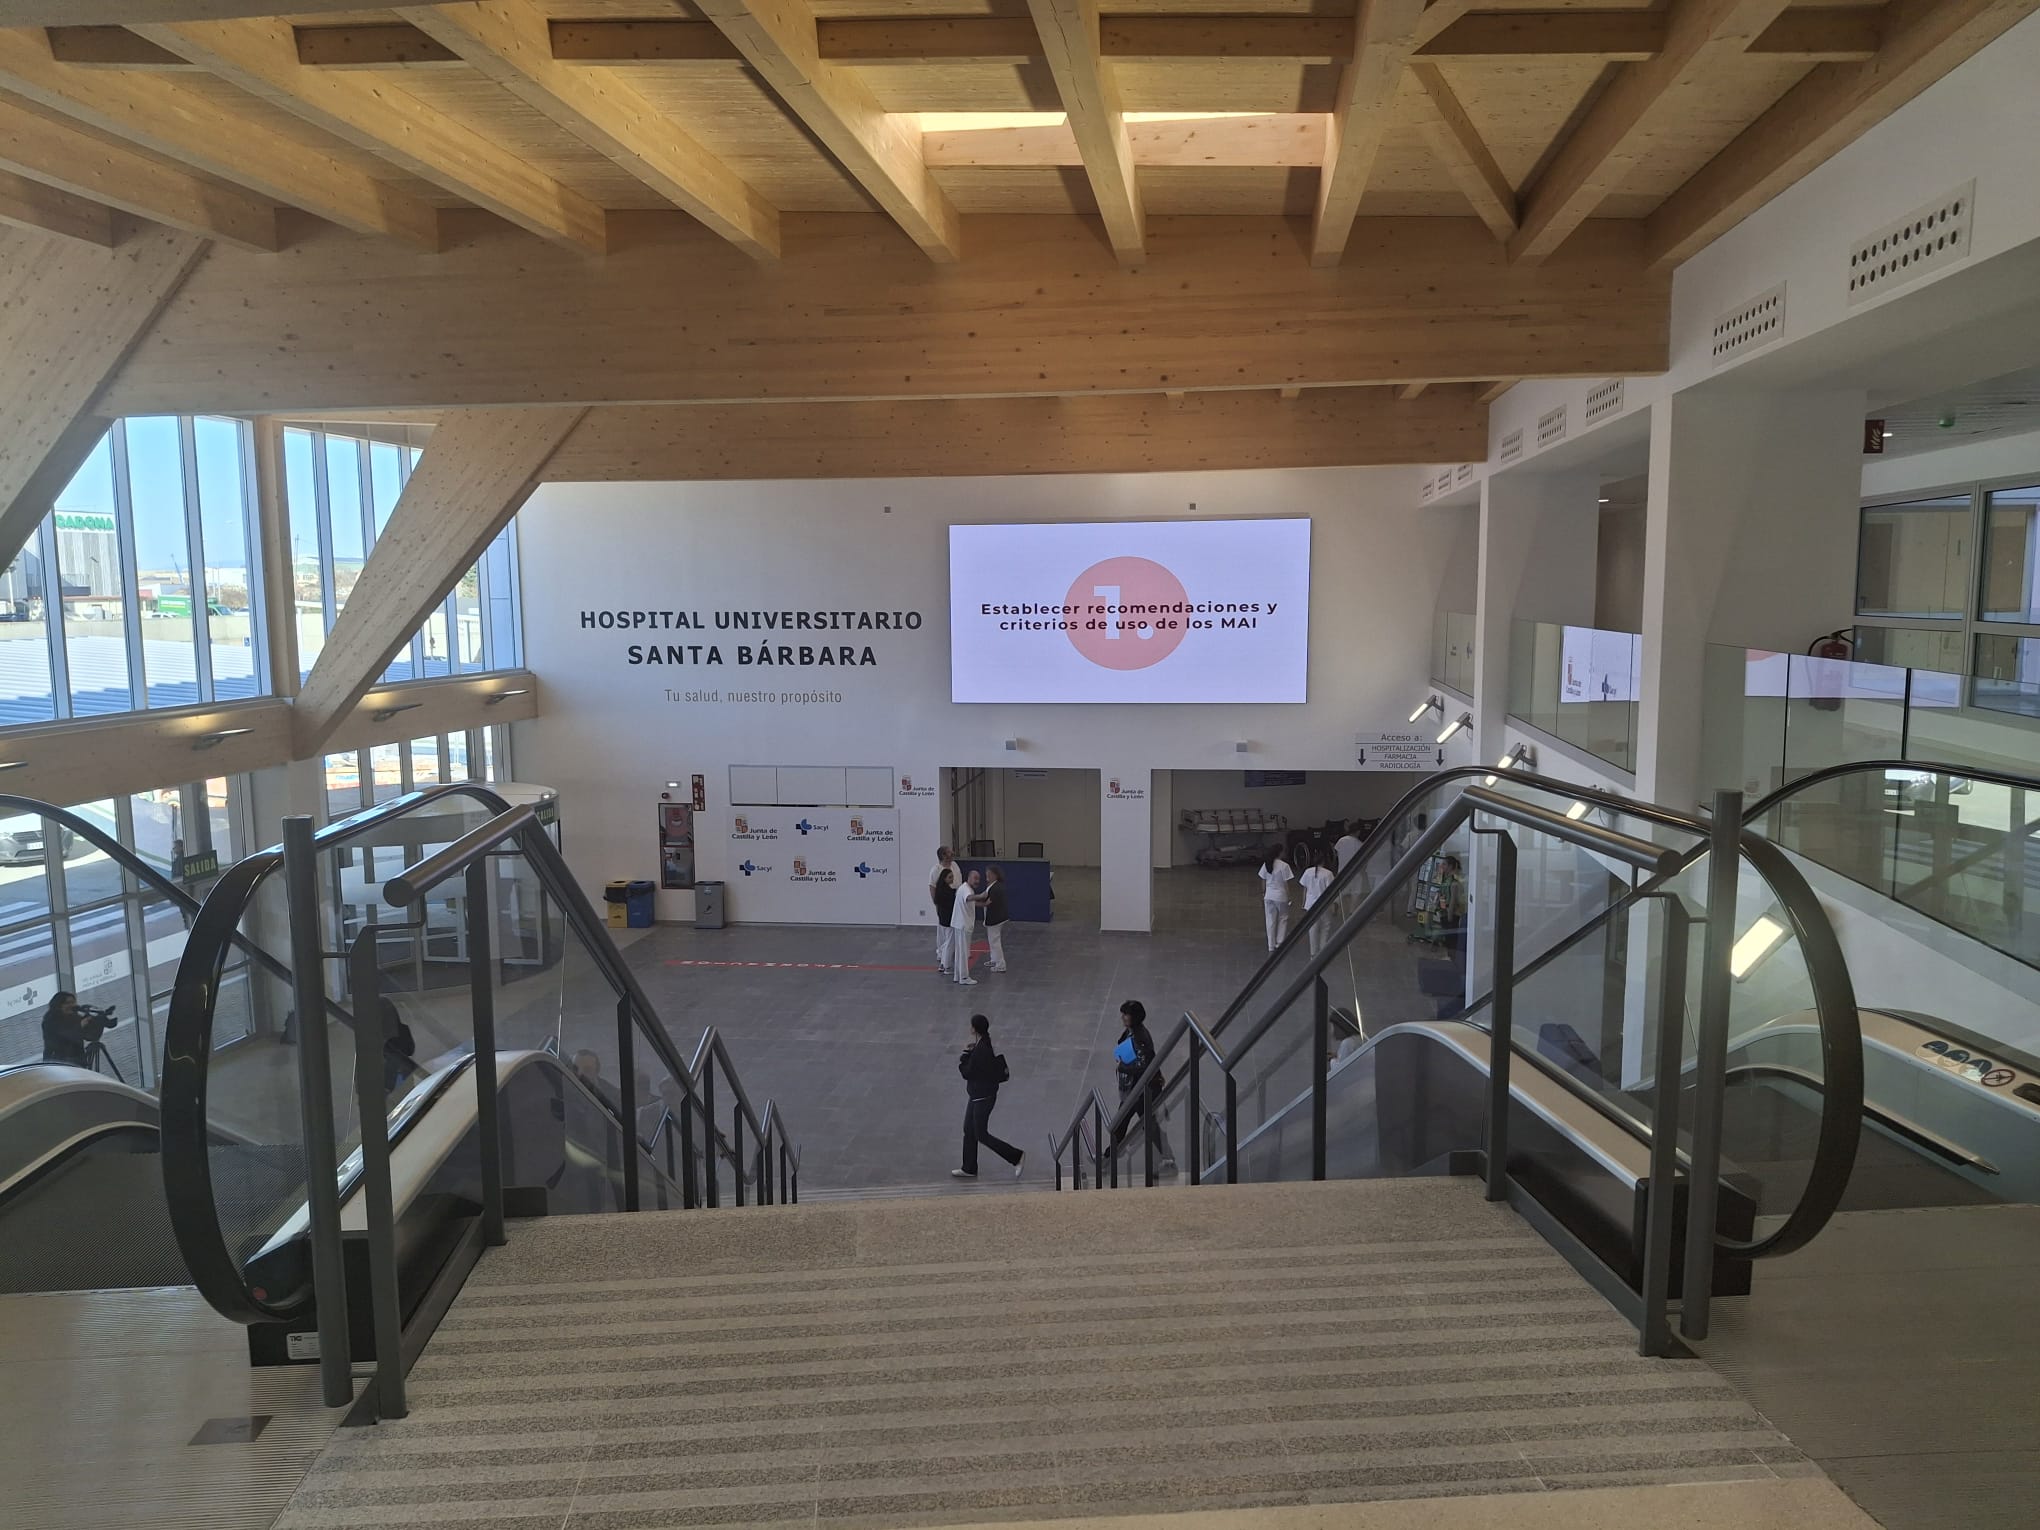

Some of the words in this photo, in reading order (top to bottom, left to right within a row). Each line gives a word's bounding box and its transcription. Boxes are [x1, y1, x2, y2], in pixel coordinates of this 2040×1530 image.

[981, 602, 1081, 615] Establecer
[1087, 600, 1261, 615] recomendaciones
[1266, 602, 1278, 615] y
[580, 610, 706, 630] HOSPITAL
[714, 611, 923, 631] UNIVERSITARIO
[999, 618, 1079, 631] criterios
[1085, 618, 1108, 631] de
[1115, 620, 1148, 631] uso
[1155, 617, 1178, 630] de
[1186, 617, 1213, 630] los
[1221, 617, 1257, 629] MAI
[628, 645, 724, 666] SANTA
[737, 639, 878, 667] BÁRBARA
[664, 689, 681, 702] Tu
[685, 689, 723, 704] salud,
[727, 691, 776, 703] nuestro
[781, 689, 843, 706] propósito
[1380, 733, 1412, 742] Acceso
[1371, 743, 1431, 752] HOSPITALIZACIÓN
[184, 857, 216, 877] SALIDA
